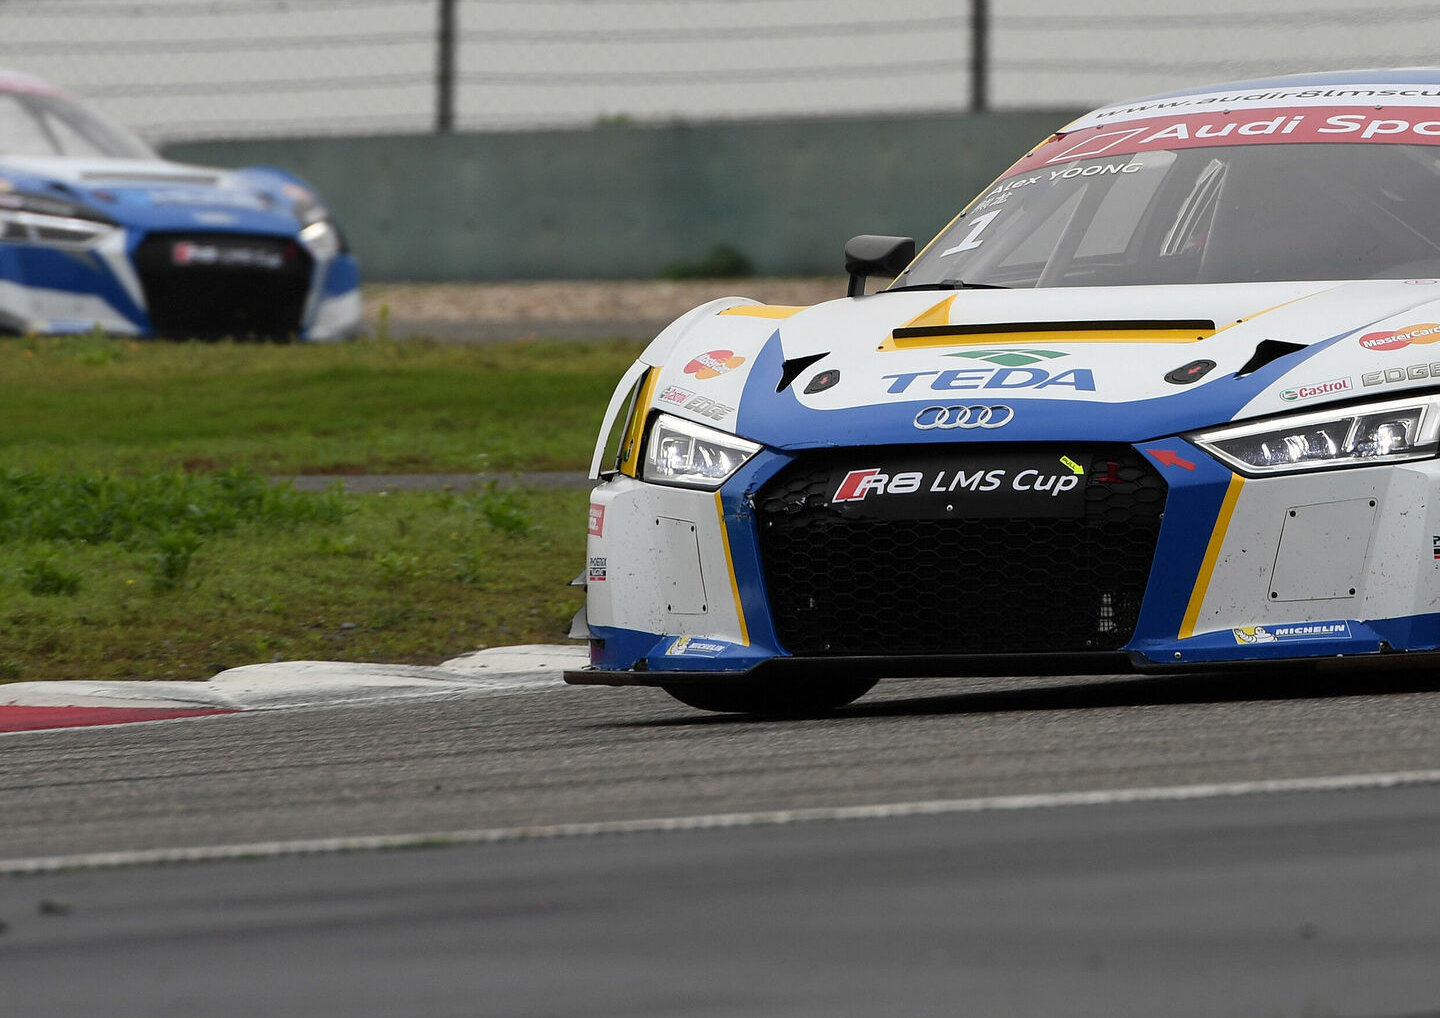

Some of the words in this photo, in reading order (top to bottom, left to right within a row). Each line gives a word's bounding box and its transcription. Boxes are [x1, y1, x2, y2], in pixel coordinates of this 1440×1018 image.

[1138, 115, 1305, 144] Audi
[986, 175, 1043, 199] Alex
[1049, 162, 1144, 181] YOONG
[939, 208, 1003, 258] 1
[881, 367, 1097, 394] TEDA
[1299, 379, 1349, 398] Castrol
[684, 395, 736, 422] EDGE
[1061, 456, 1076, 470] PULL
[851, 472, 923, 496] R8
[930, 469, 1006, 492] LMS
[1012, 469, 1079, 497] Cup
[1275, 624, 1346, 636] MICHELIN
